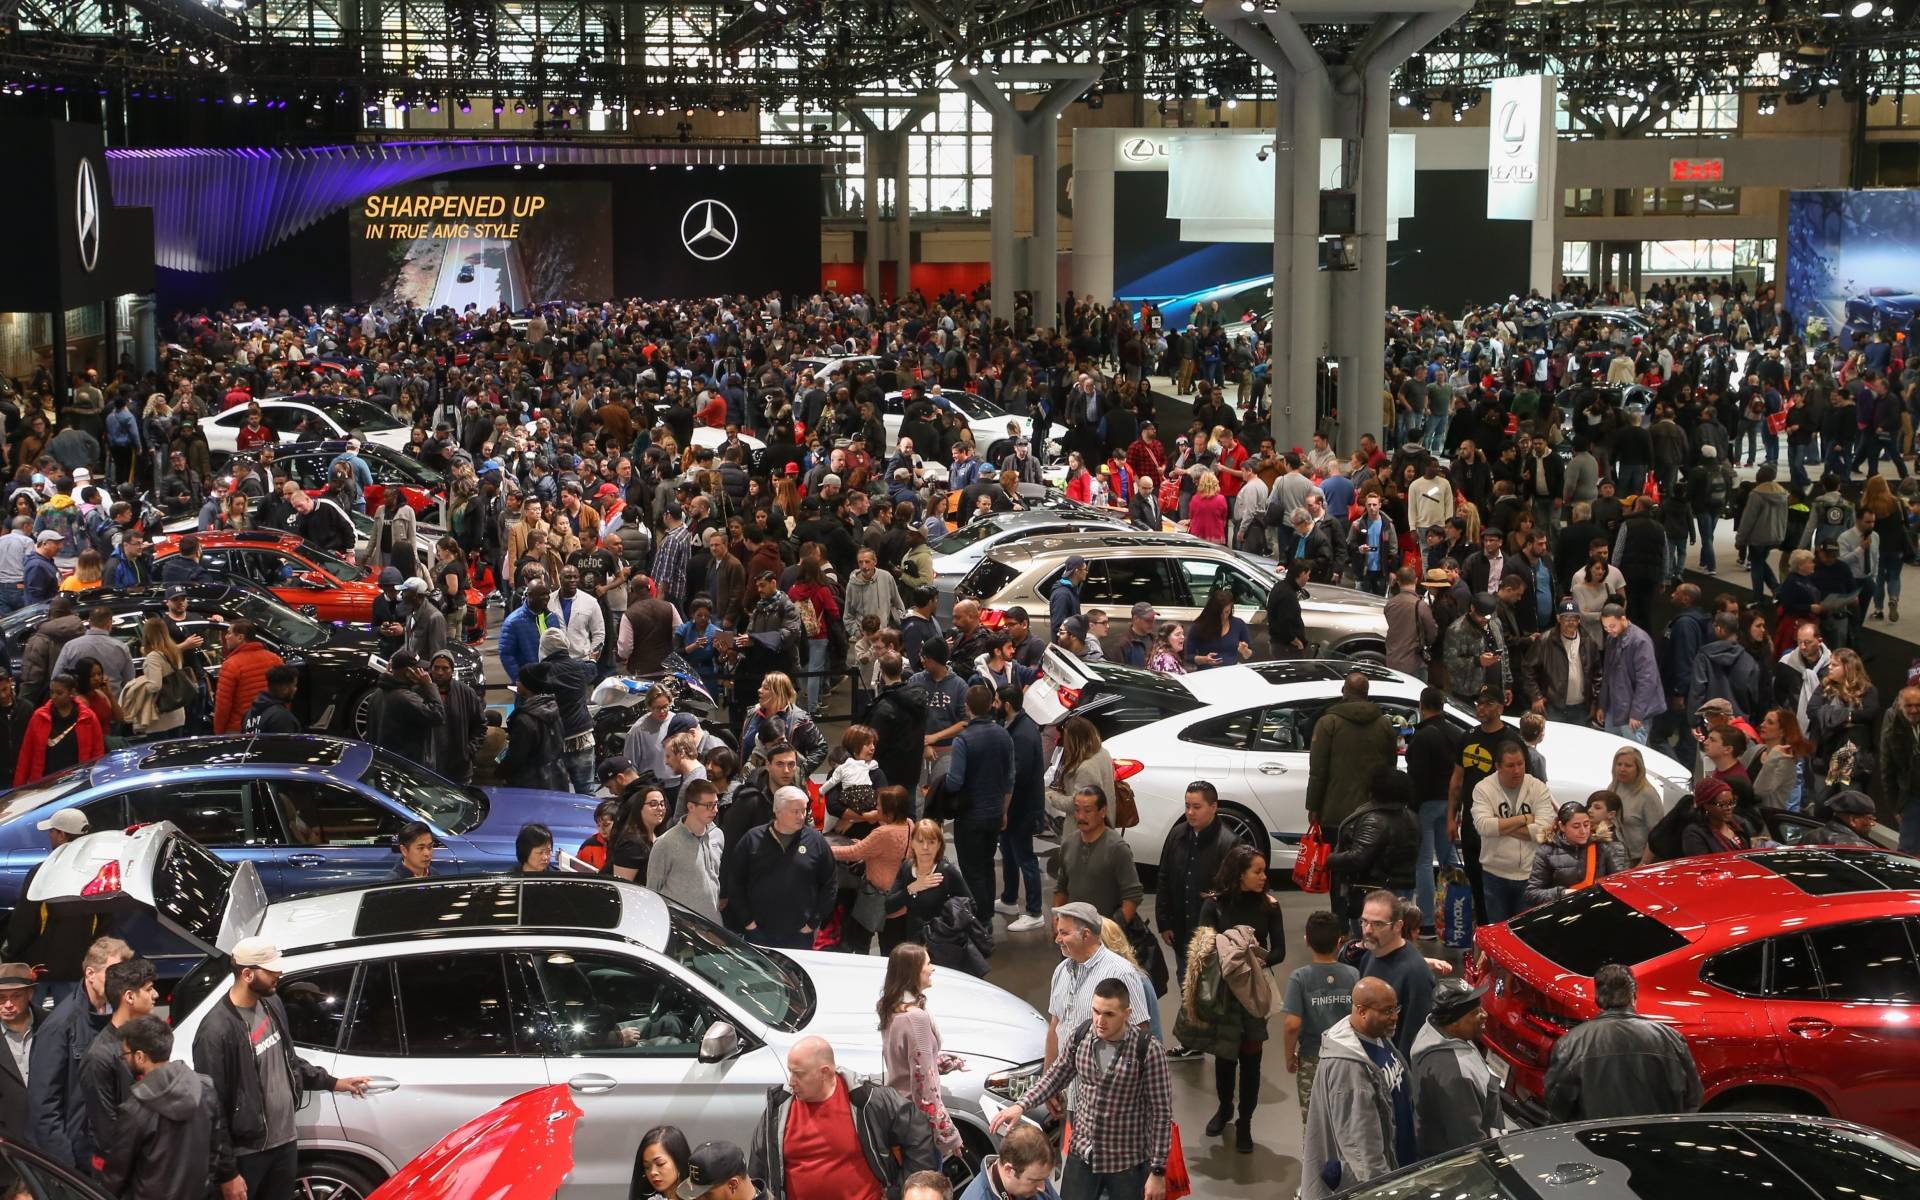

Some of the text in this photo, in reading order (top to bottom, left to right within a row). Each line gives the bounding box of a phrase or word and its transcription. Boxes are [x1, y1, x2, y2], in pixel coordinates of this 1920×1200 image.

[1489, 164, 1537, 184] LEXUS
[364, 195, 545, 218] SHARPENED UP
[365, 224, 520, 239] IN TRUE AMG STYLE
[1311, 995, 1352, 1006] FINISHER
